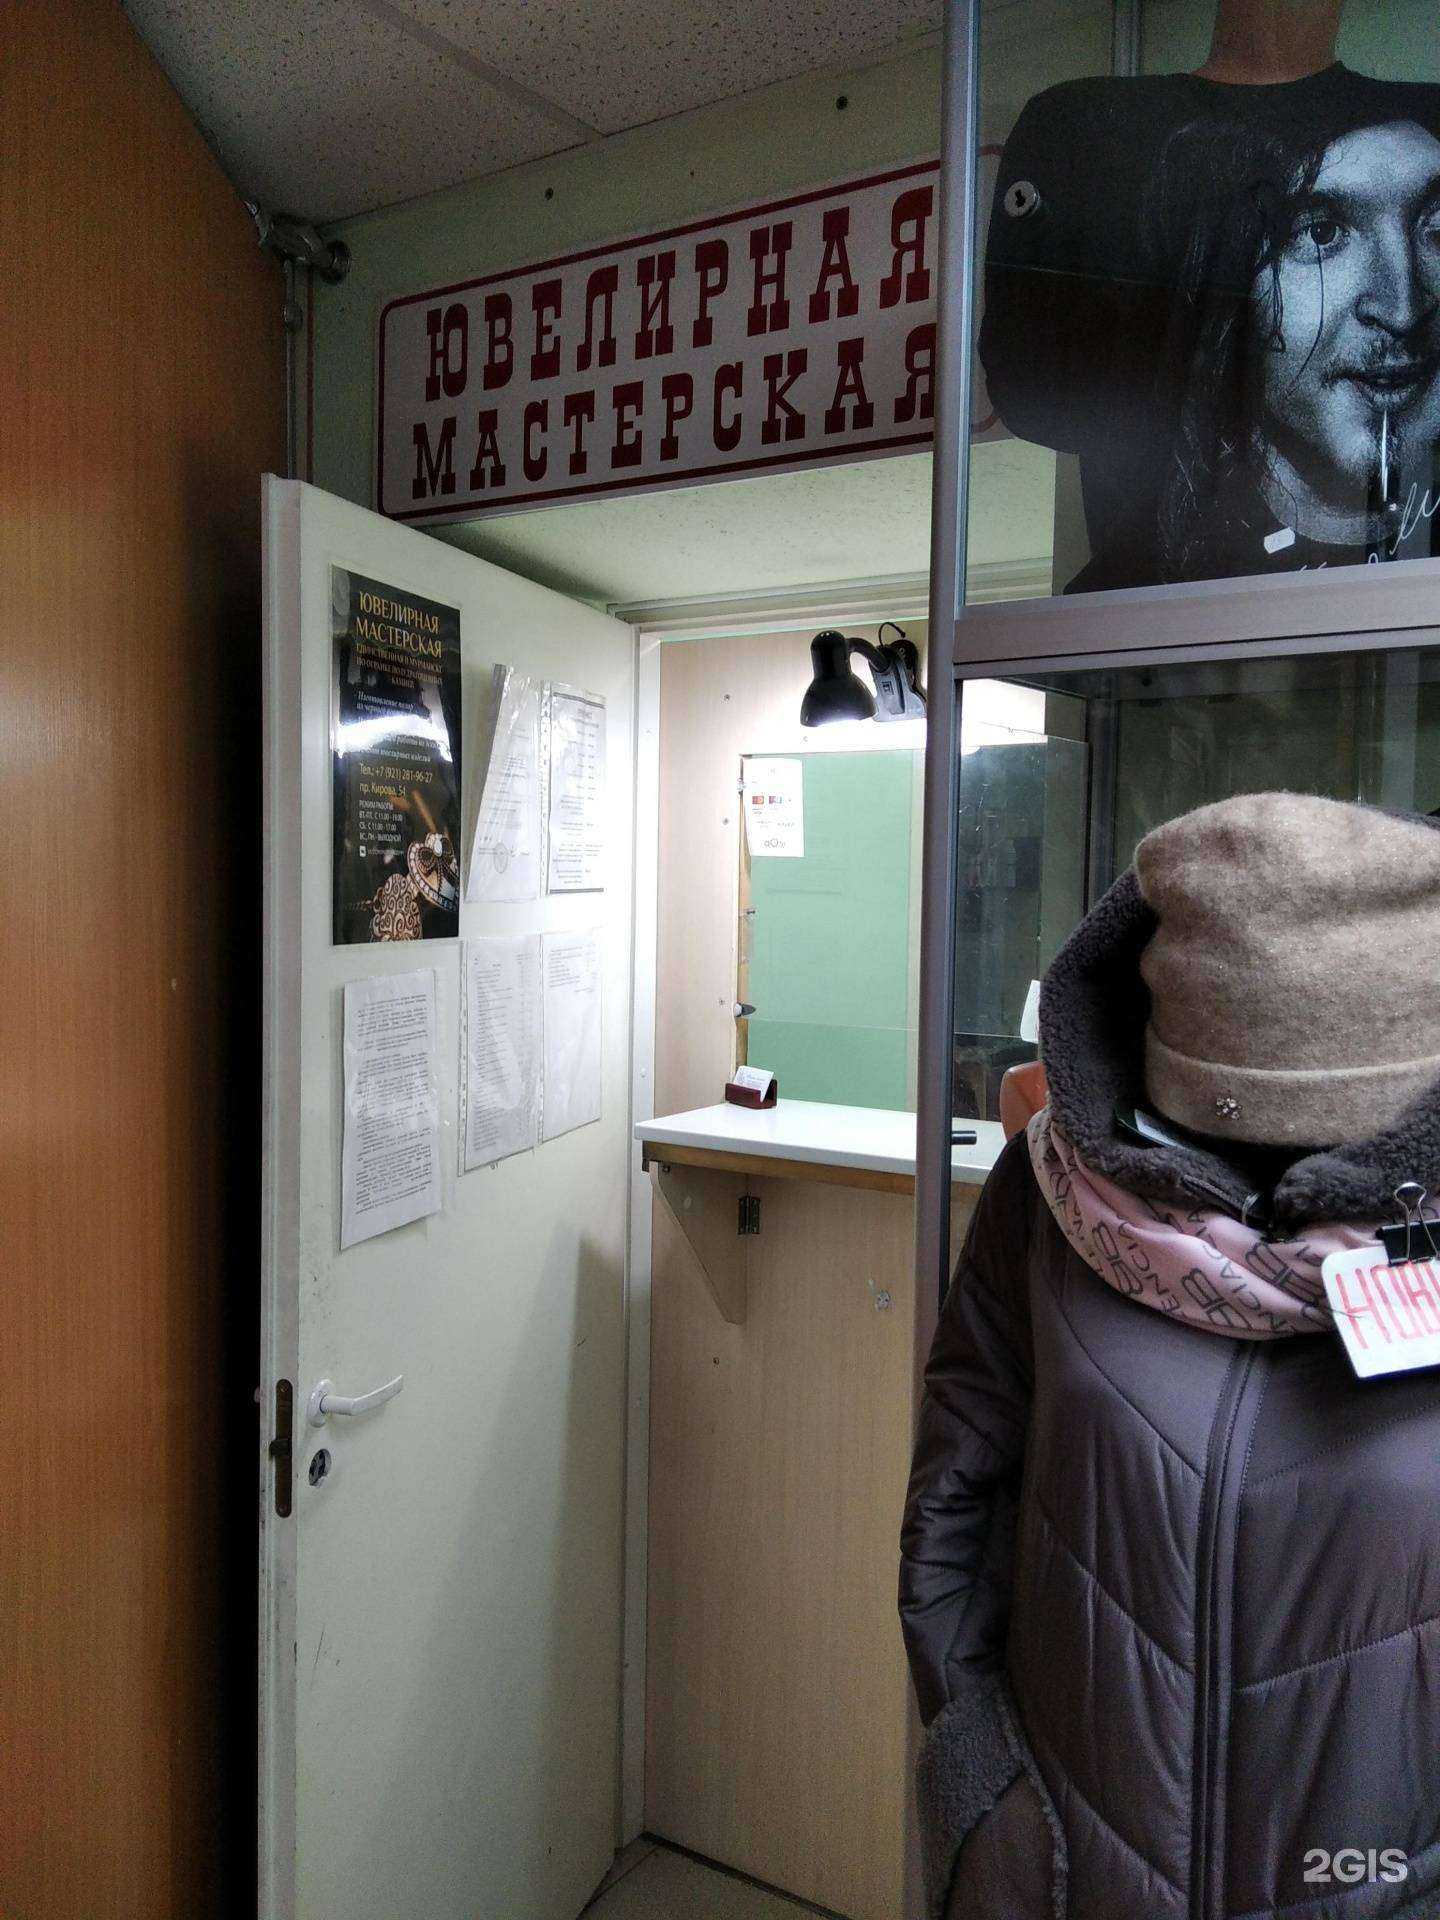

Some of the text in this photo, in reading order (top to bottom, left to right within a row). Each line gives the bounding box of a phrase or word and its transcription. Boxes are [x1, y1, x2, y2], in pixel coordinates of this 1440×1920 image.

[426, 185, 933, 402] ЮВЕЛИРНАЯ
[412, 322, 937, 499] МАСТЕРСКАЯ
[356, 616, 442, 659] МАСТЕРСКАЯ
[359, 591, 440, 635] ЮВЕЛИРНАЯ
